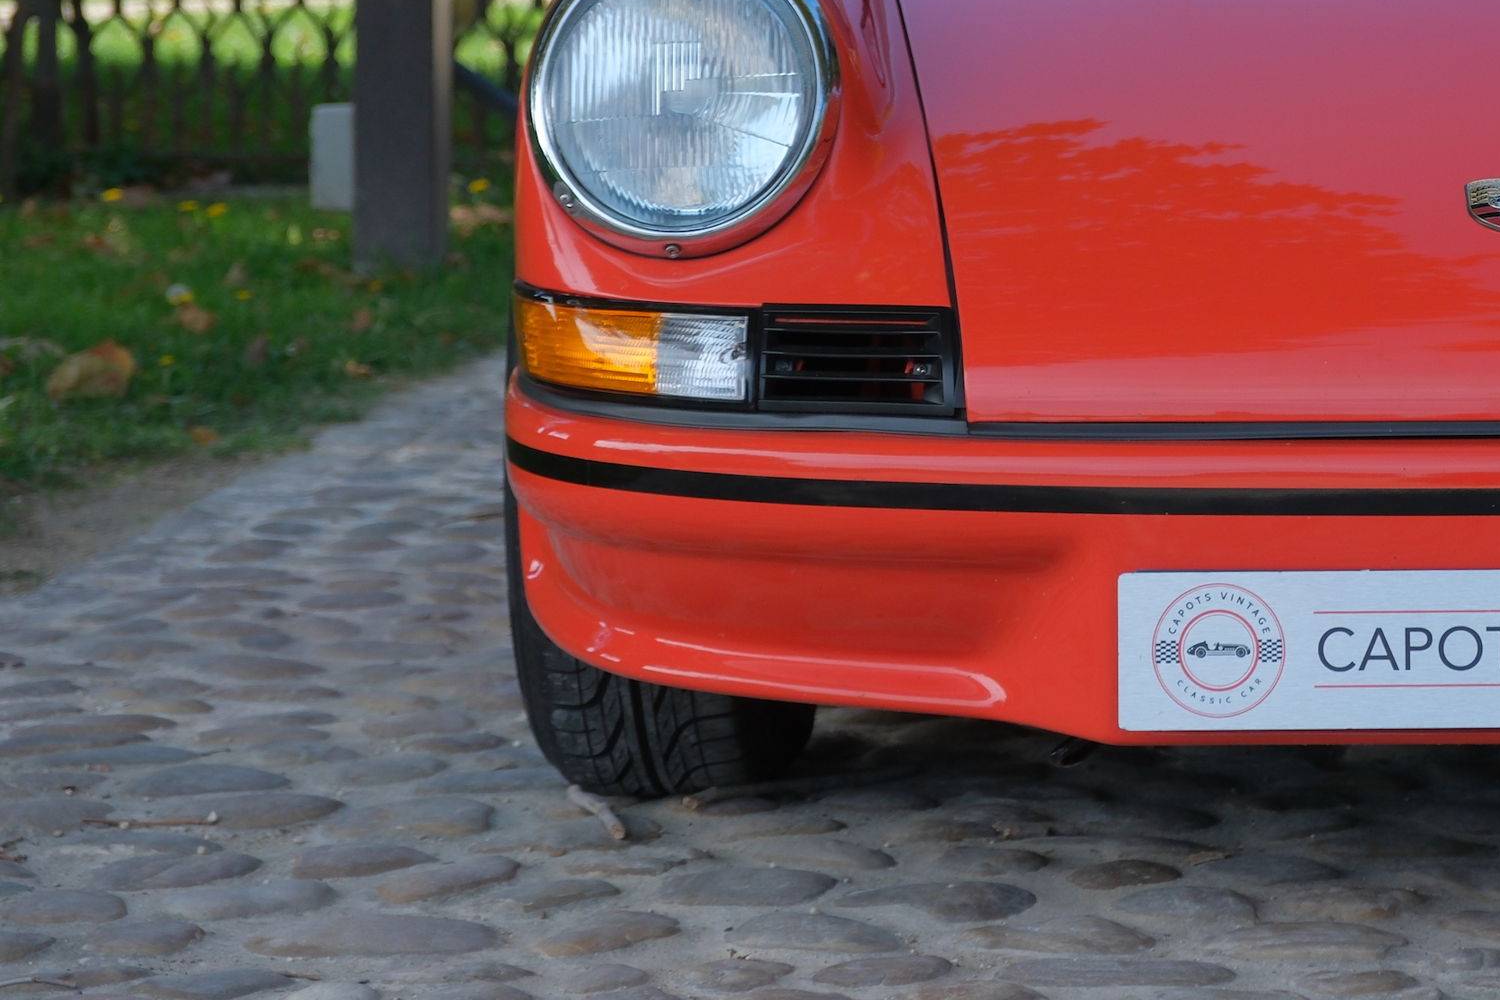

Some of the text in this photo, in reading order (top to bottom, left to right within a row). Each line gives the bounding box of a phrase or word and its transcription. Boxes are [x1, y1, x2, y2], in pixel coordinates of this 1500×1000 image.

[1168, 592, 1271, 635] CAPOTS VINTAGE
[1177, 678, 1262, 704] CLASSIC CAR
